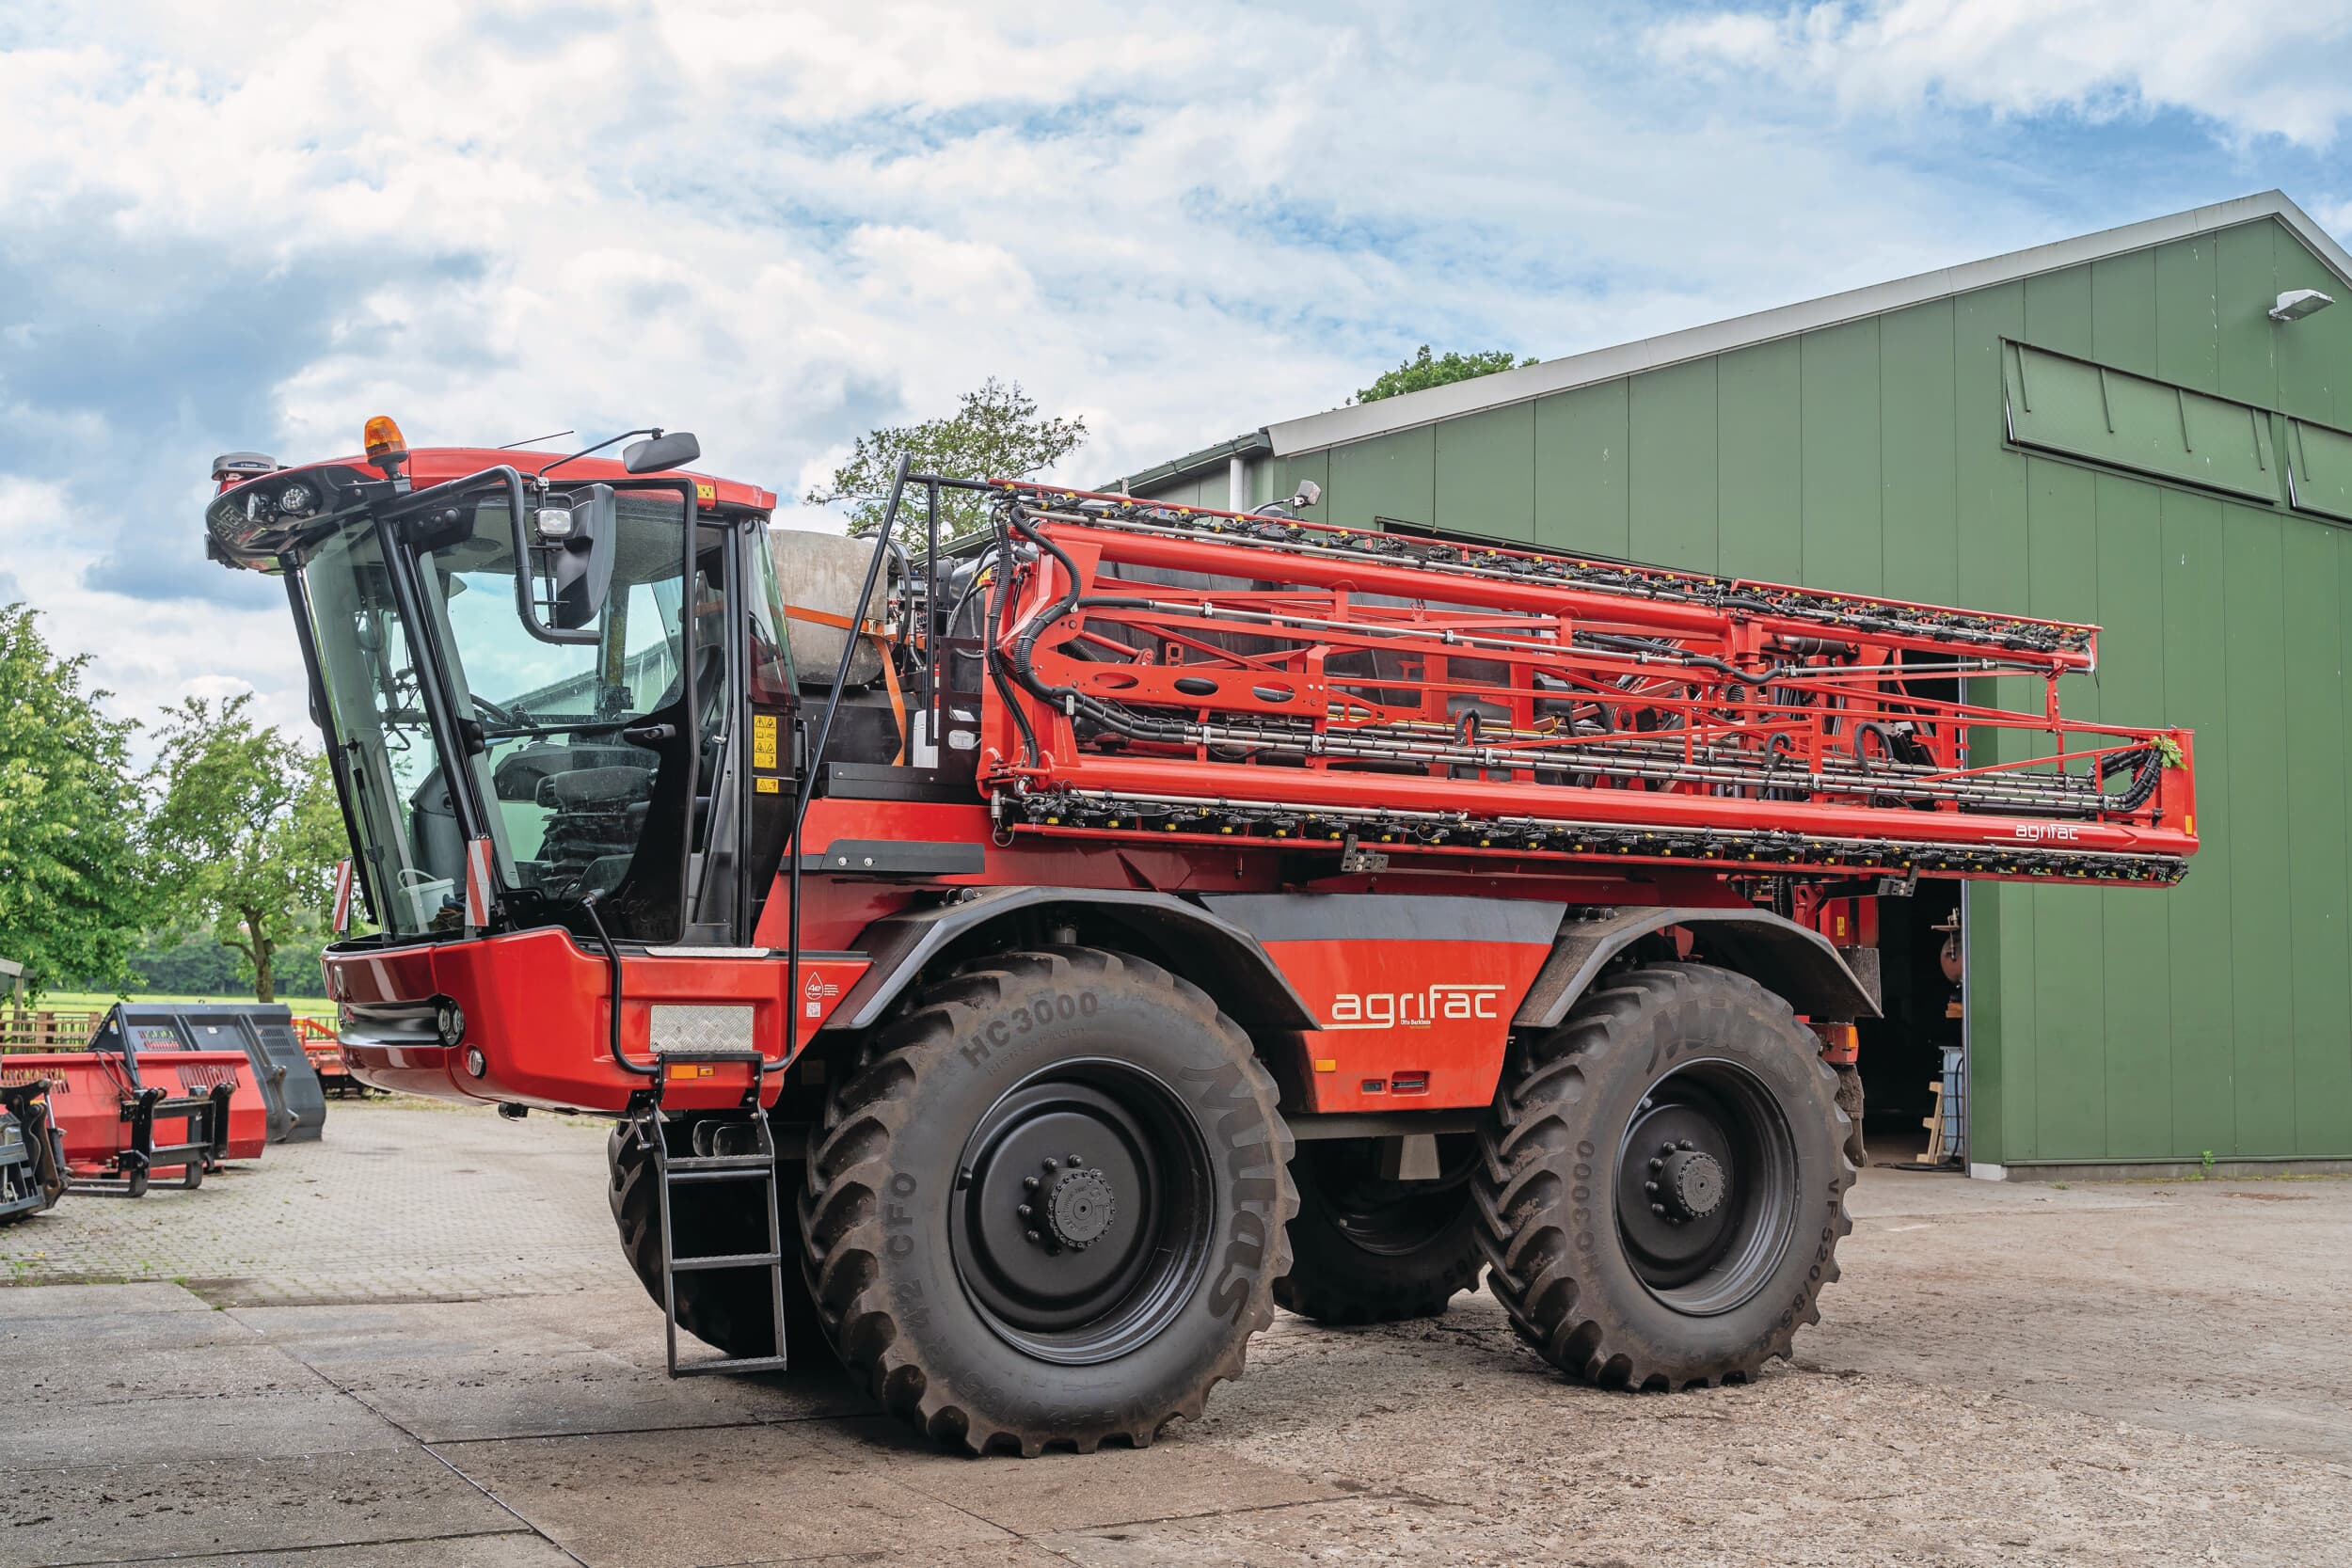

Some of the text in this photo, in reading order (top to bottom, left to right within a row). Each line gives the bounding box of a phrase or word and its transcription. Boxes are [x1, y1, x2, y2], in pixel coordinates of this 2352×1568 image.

[1983, 823, 2105, 842] agrifac
[960, 991, 1098, 1069] HC3000
[1322, 984, 1505, 1030] agrifac
[887, 1172, 916, 1259] CFO
[1177, 1061, 1276, 1326] Mitas
[1827, 1178, 1839, 1219] VF
[1781, 1226, 1835, 1330] 520/85
